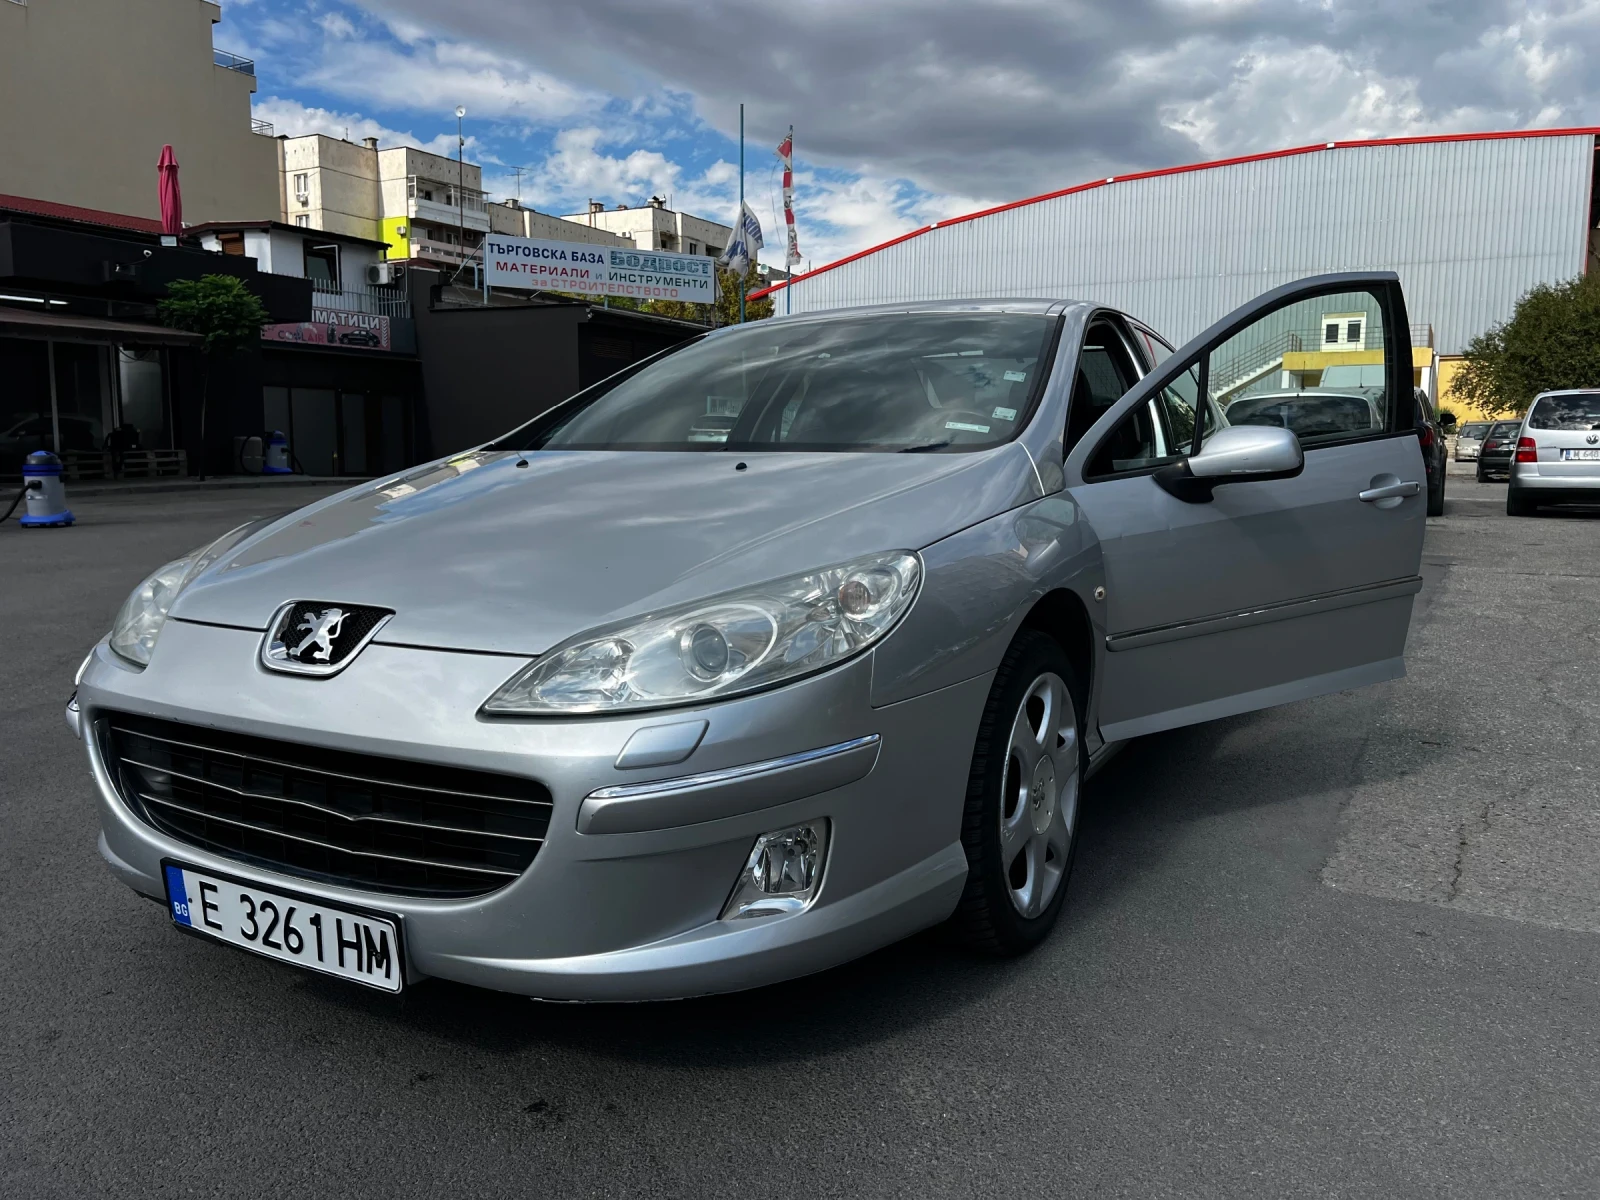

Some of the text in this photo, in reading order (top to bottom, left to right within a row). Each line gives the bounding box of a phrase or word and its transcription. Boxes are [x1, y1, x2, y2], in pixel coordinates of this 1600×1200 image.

[488, 242, 604, 264] ТЪРГОВСКА БАЗА
[496, 261, 590, 279] МАТЕРИАЛИ
[608, 271, 708, 289] ИНСТРУМЕНТИ
[531, 278, 679, 298] за СТРОИТЕЛСТВОТО
[174, 901, 188, 916] BG
[199, 881, 391, 979] E 3261 HM
